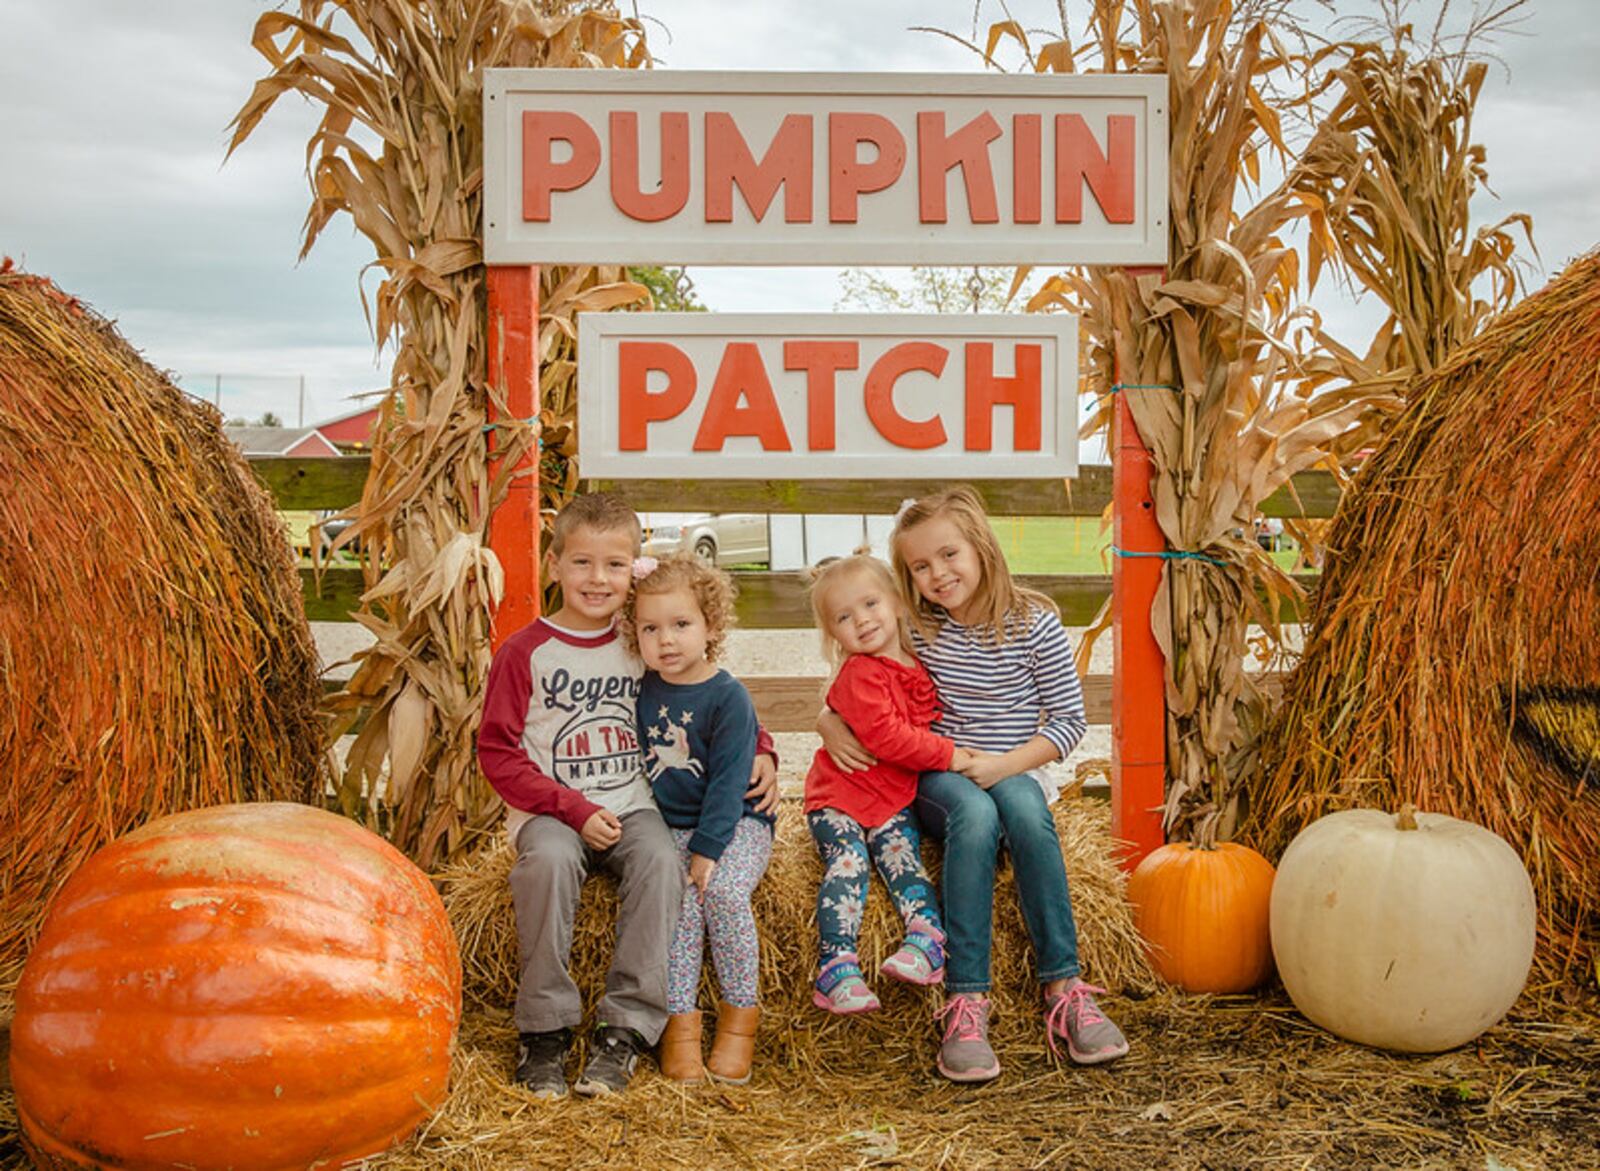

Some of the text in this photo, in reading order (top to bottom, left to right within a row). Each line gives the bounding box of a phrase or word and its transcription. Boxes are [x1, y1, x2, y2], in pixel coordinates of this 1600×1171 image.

[522, 110, 1136, 224] PUMPKIN
[618, 341, 1042, 452] PATCH
[566, 726, 637, 757] IN THE
